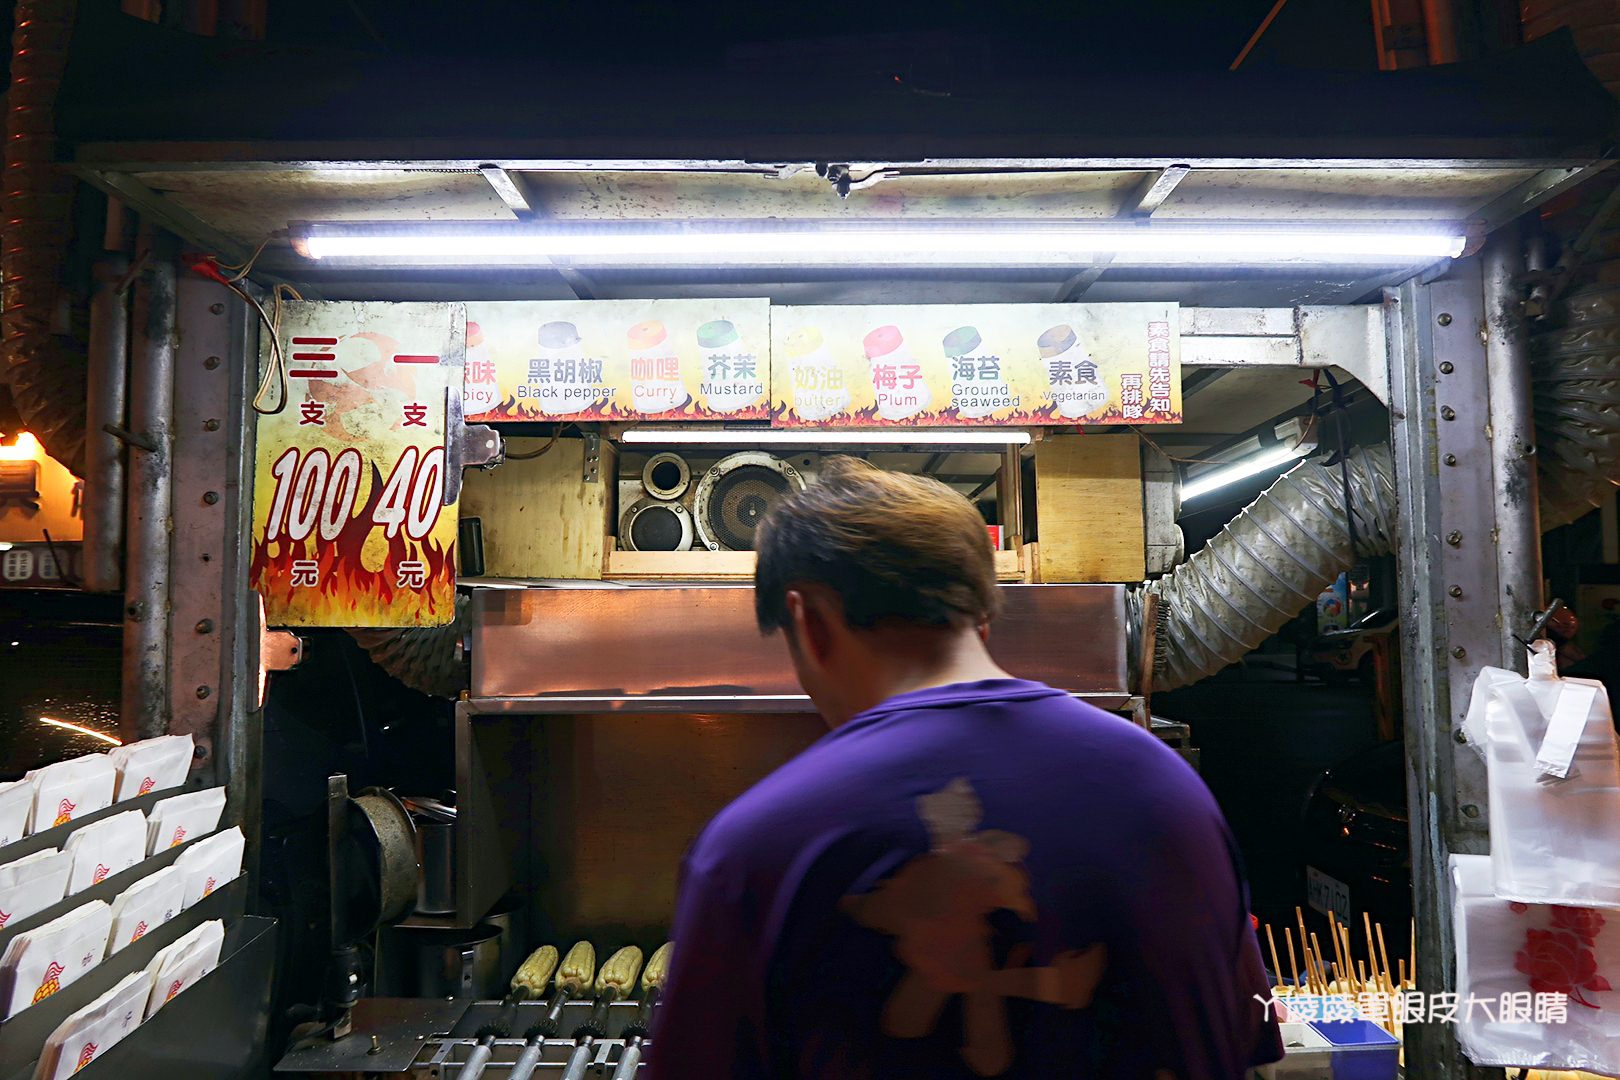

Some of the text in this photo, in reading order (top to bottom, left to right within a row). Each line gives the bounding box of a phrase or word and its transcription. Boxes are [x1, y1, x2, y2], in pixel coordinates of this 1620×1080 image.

[289, 336, 339, 378] 三
[630, 356, 680, 381] 咖哩
[951, 355, 1001, 381] 海苔
[1147, 321, 1171, 413] 素食請先告知
[464, 359, 497, 385] 味
[527, 357, 604, 384] 黑胡椒
[794, 364, 843, 391] 奶油
[872, 363, 923, 390] 梅子
[1048, 359, 1099, 386] 素食
[463, 388, 494, 404] picy
[516, 384, 617, 402] Black pepper
[633, 384, 678, 403] Curry
[699, 382, 764, 396] Mustard
[794, 394, 841, 407] butter
[878, 393, 918, 406] Plum
[951, 383, 1009, 396] Ground
[951, 395, 1021, 408] seaweed
[1043, 390, 1106, 403] Vegetarian
[1120, 373, 1144, 419] 再排隊
[299, 401, 326, 426] 支
[402, 403, 429, 428] 支
[267, 447, 363, 541] 100
[371, 446, 446, 541] 40
[291, 560, 320, 587] 元
[398, 560, 428, 588] 元
